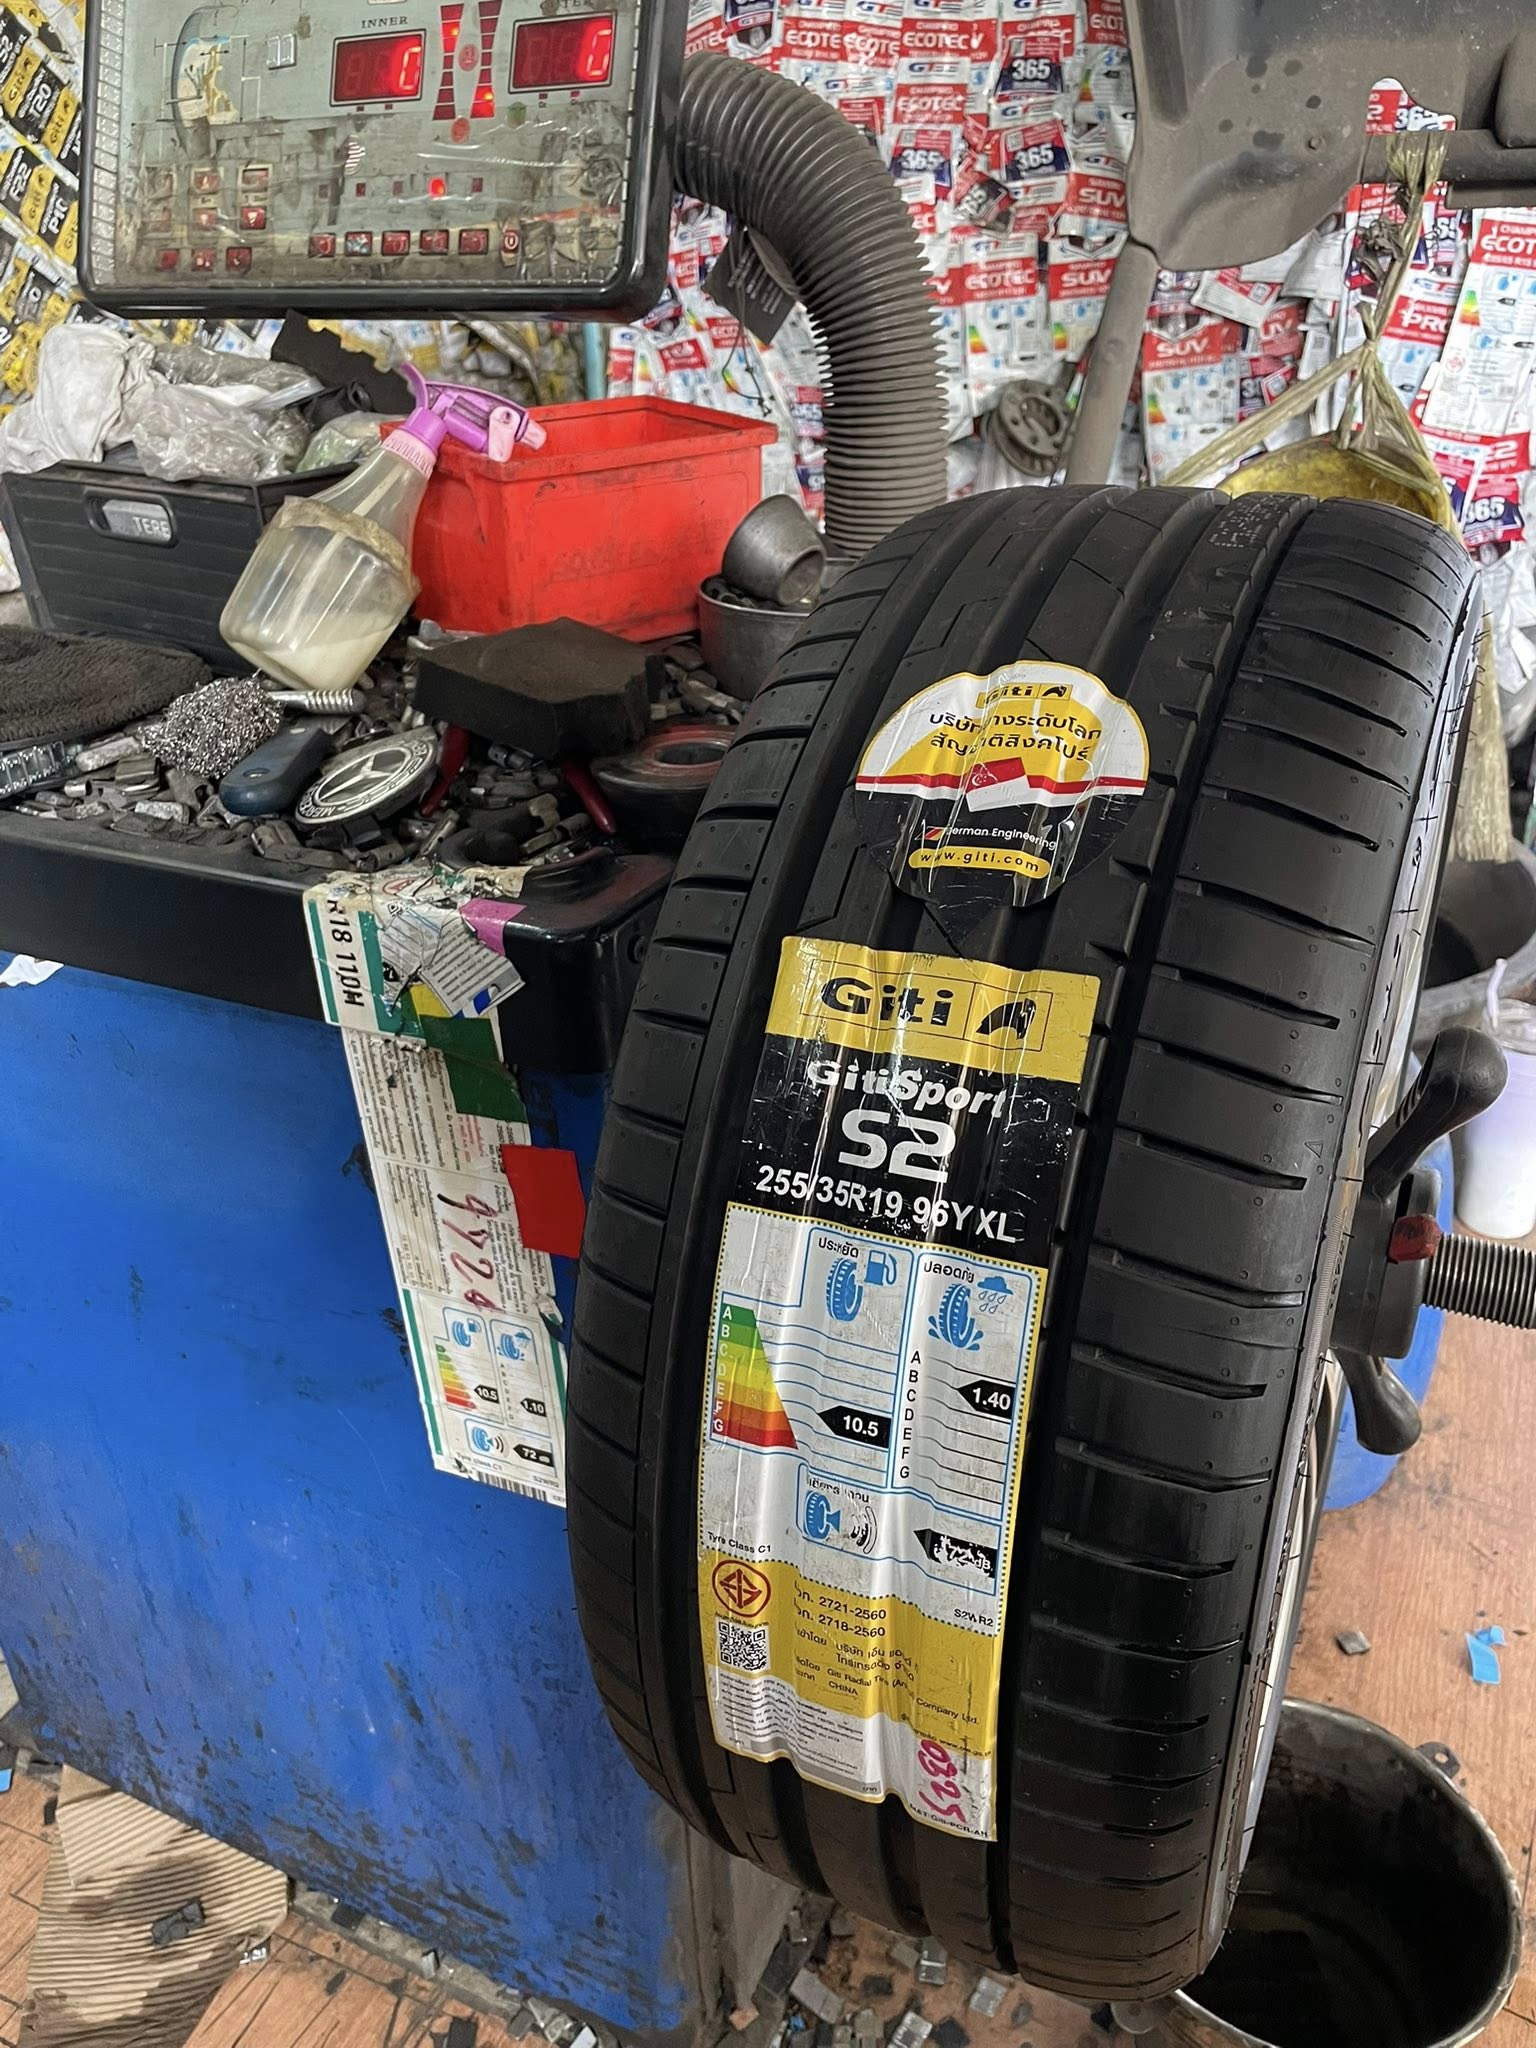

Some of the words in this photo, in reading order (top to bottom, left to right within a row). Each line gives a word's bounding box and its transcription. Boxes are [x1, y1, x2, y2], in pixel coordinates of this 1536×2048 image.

[361, 16, 408, 29] INNER
[902, 31, 970, 50] ECOTEC
[1012, 59, 1051, 81] 365
[901, 148, 944, 170] 365
[1015, 144, 1055, 171] 365
[1079, 187, 1125, 208] SUV
[1481, 234, 1536, 255] ECOT
[964, 269, 1037, 291] ECOTEC
[1061, 269, 1112, 288] SUV
[1156, 337, 1209, 358] SUV
[929, 712, 1102, 740] บริษัทางระดับโลก
[991, 828, 1057, 850] Engineering
[821, 977, 953, 1027] Giti
[807, 1058, 1007, 1118] GitiSport
[838, 1108, 956, 1184] S2
[756, 1165, 903, 1219] 255/35R19
[912, 1196, 975, 1232] 96Y
[975, 1207, 1016, 1244] XL
[818, 1235, 860, 1259] ประหยัด
[923, 1260, 976, 1284] ปลอดภัย
[722, 1306, 733, 1320] A
[721, 1325, 730, 1338] B
[910, 1350, 921, 1365] A
[908, 1369, 919, 1383] B
[477, 1386, 498, 1401] 10.5
[716, 1382, 726, 1395] E
[906, 1388, 916, 1402] C
[972, 1387, 1011, 1411] 1.40
[523, 1399, 545, 1415] 1.10
[904, 1408, 914, 1421] D
[713, 1418, 724, 1432] G
[843, 1415, 879, 1438] 10.5
[903, 1427, 912, 1441] E
[523, 1446, 537, 1460] 72
[901, 1446, 911, 1460] F
[899, 1465, 910, 1479] G
[707, 1531, 726, 1545] Tyre
[728, 1538, 755, 1554] Class
[757, 1544, 771, 1554] C1
[818, 1595, 888, 1621] 2721-2560
[818, 1613, 887, 1638] 2718-2560
[827, 1667, 843, 1681] Giti
[844, 1673, 873, 1687] Radial
[916, 1697, 959, 1719] Company
[961, 1712, 981, 1726] Ltd.
[828, 1680, 859, 1697] CHINA
